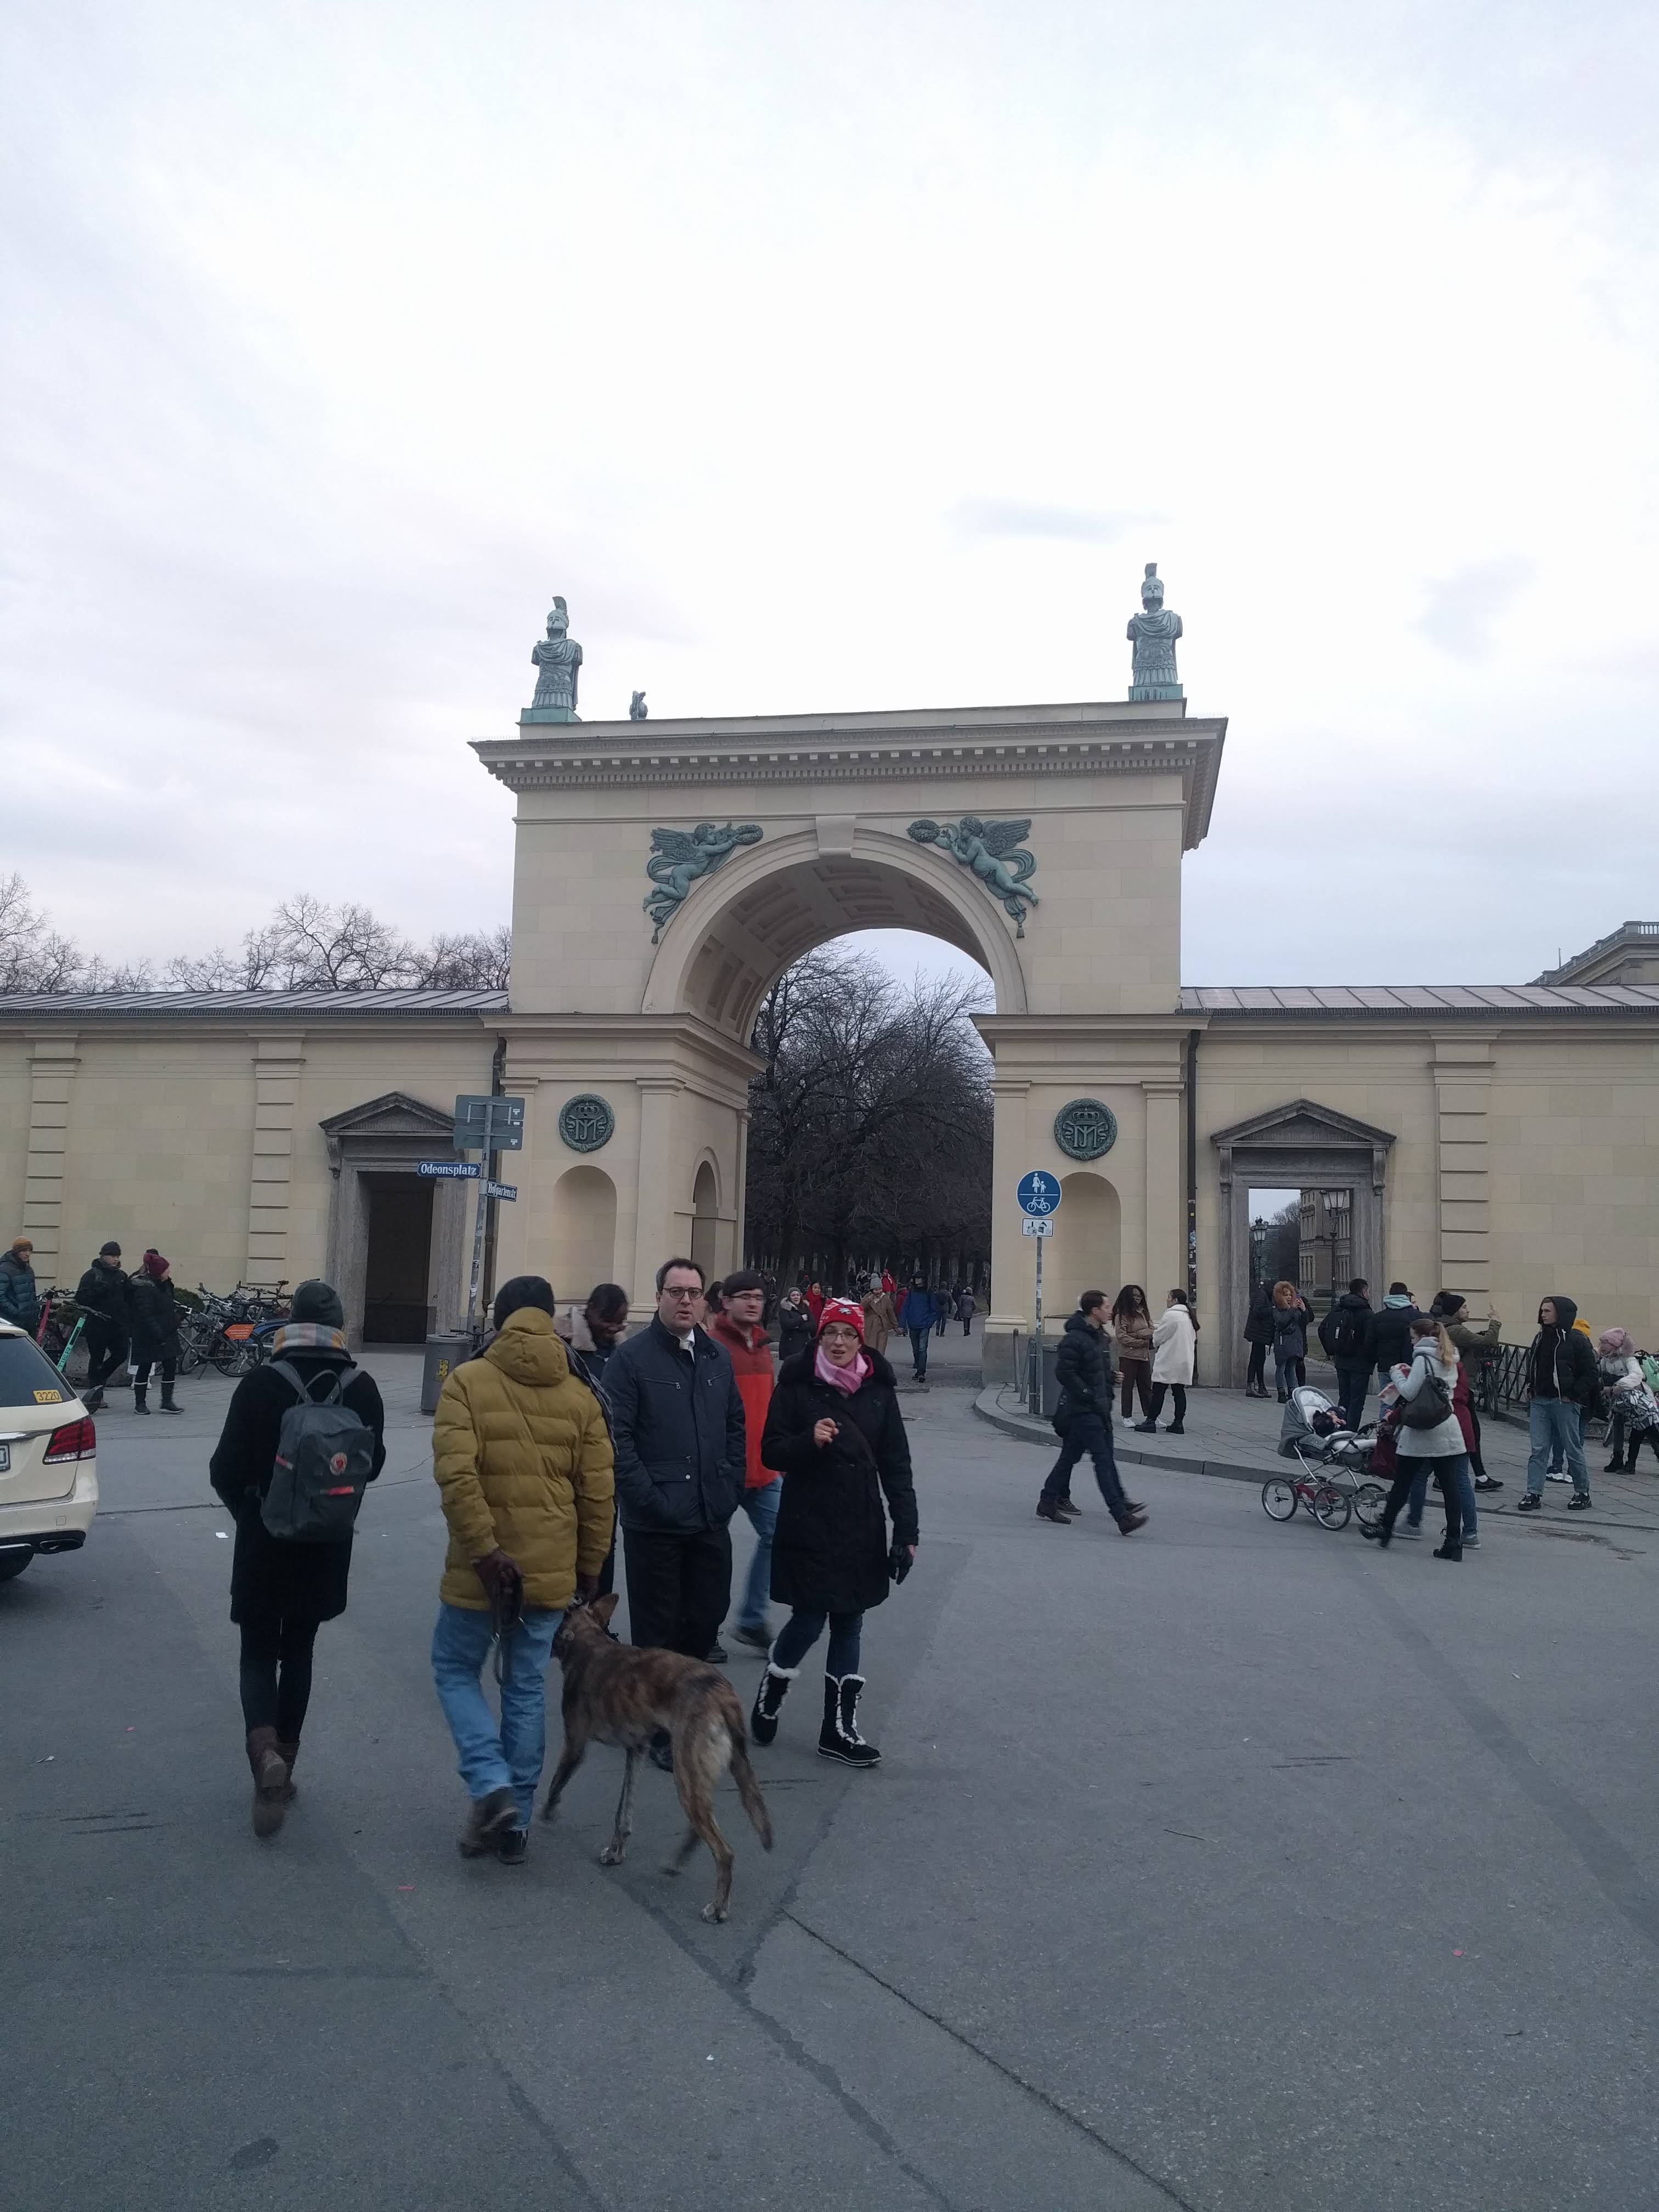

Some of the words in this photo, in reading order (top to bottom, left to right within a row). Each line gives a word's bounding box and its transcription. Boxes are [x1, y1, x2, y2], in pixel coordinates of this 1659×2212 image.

[420, 1163, 477, 1176] Odeonsplatz
[58, 1347, 71, 1369] TIER
[36, 1391, 60, 1401] 3220
